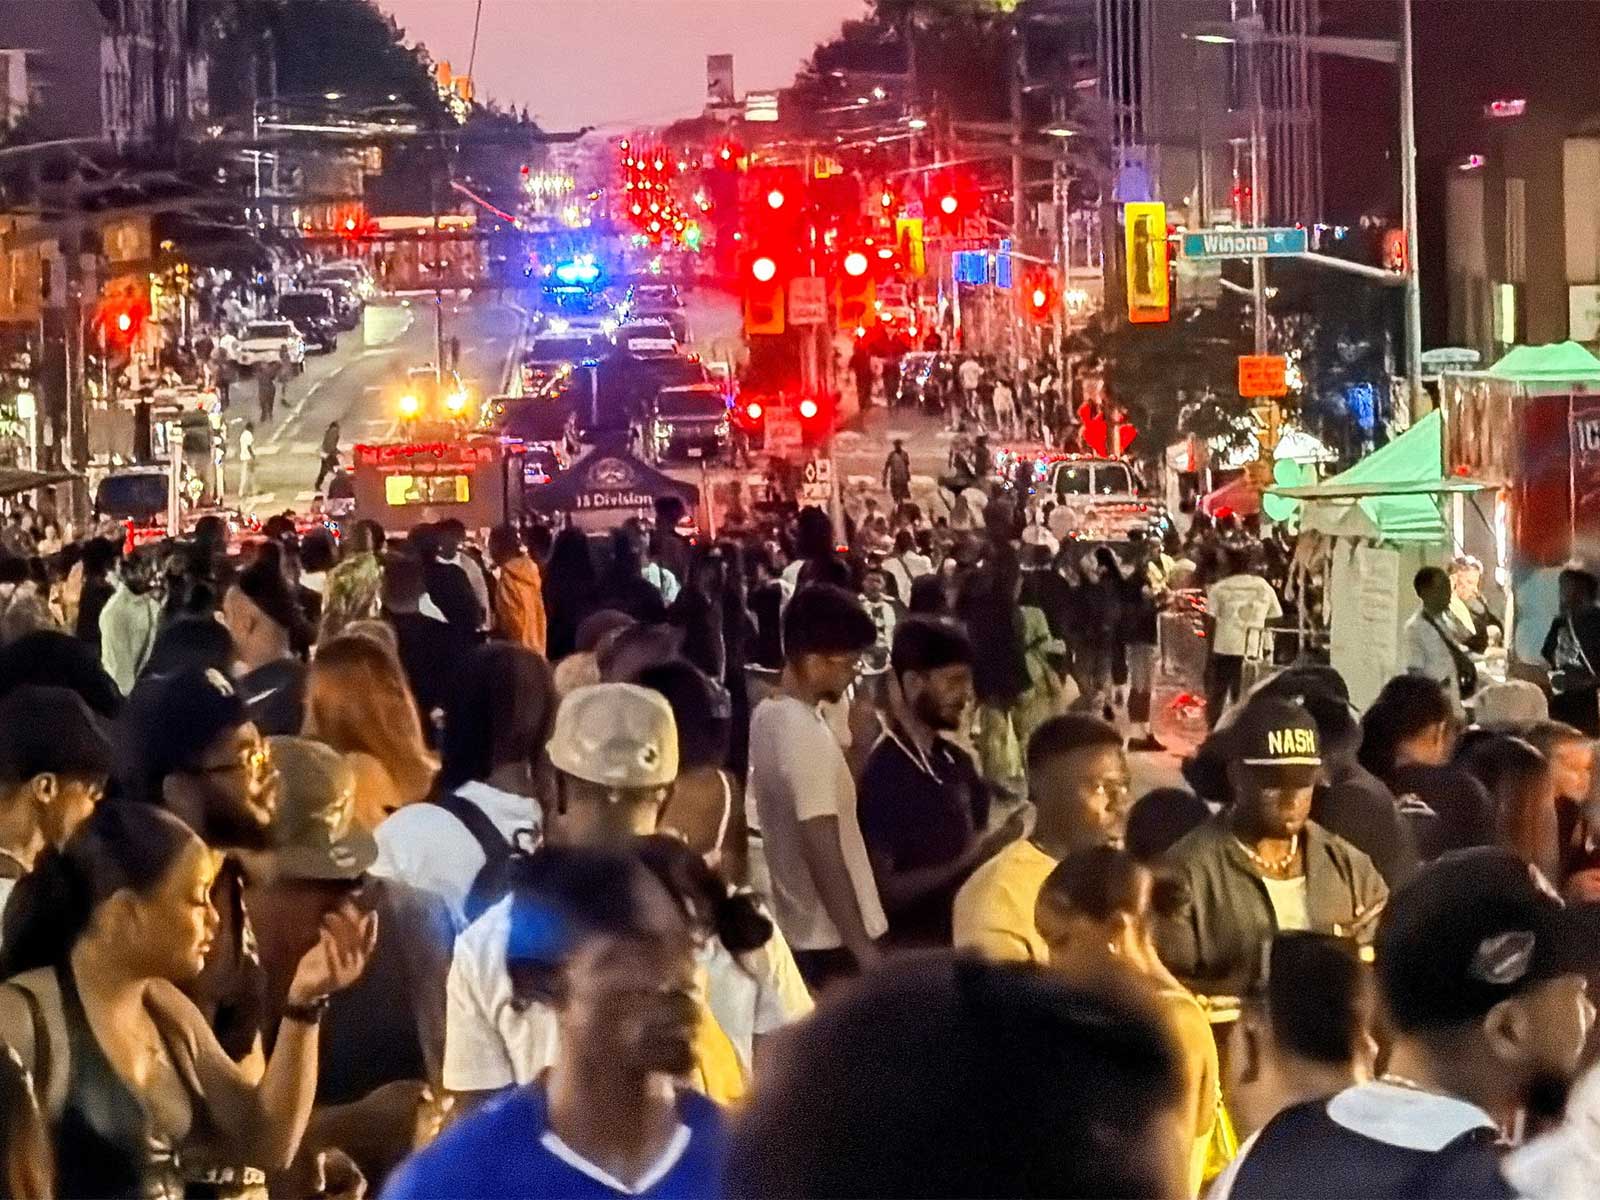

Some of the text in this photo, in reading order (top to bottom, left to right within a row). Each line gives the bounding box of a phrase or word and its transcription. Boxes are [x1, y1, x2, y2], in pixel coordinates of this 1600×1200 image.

[1203, 233, 1268, 253] Winona
[593, 491, 653, 507] Division
[1267, 727, 1316, 755] NASH
